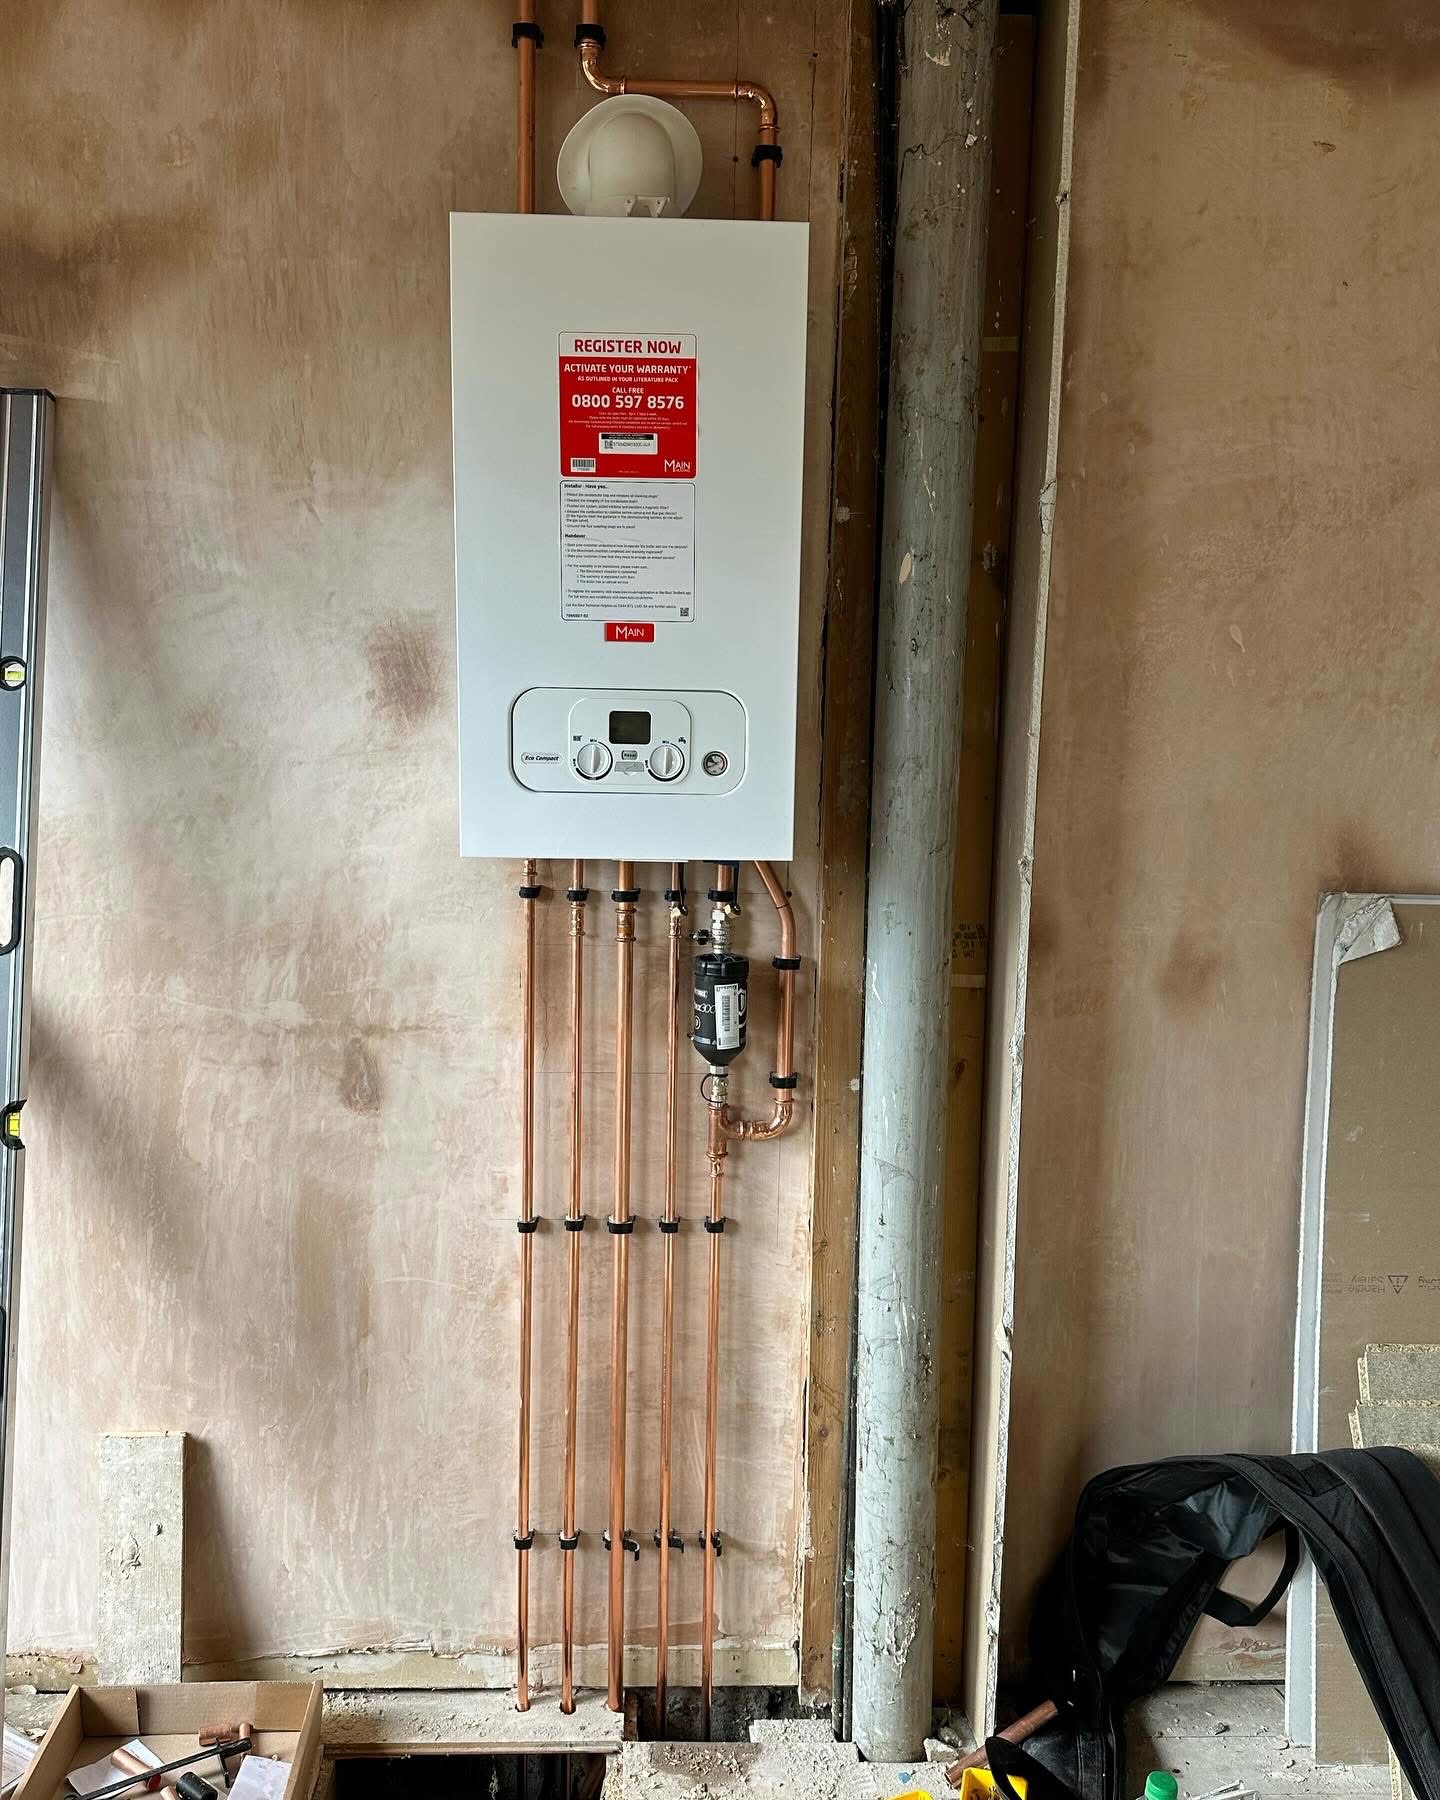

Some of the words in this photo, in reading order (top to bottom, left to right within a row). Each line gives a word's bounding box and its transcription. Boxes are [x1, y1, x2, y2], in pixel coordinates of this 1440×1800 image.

[574, 340, 643, 353] REGISTER
[647, 341, 681, 354] NOW
[564, 364, 607, 373] ACTIVATE
[609, 364, 634, 373] YOUR
[572, 394, 610, 408] 0800
[615, 395, 642, 409] 597
[647, 396, 684, 409] 8576
[664, 459, 690, 472] MAIN
[615, 625, 645, 640] MAIN
